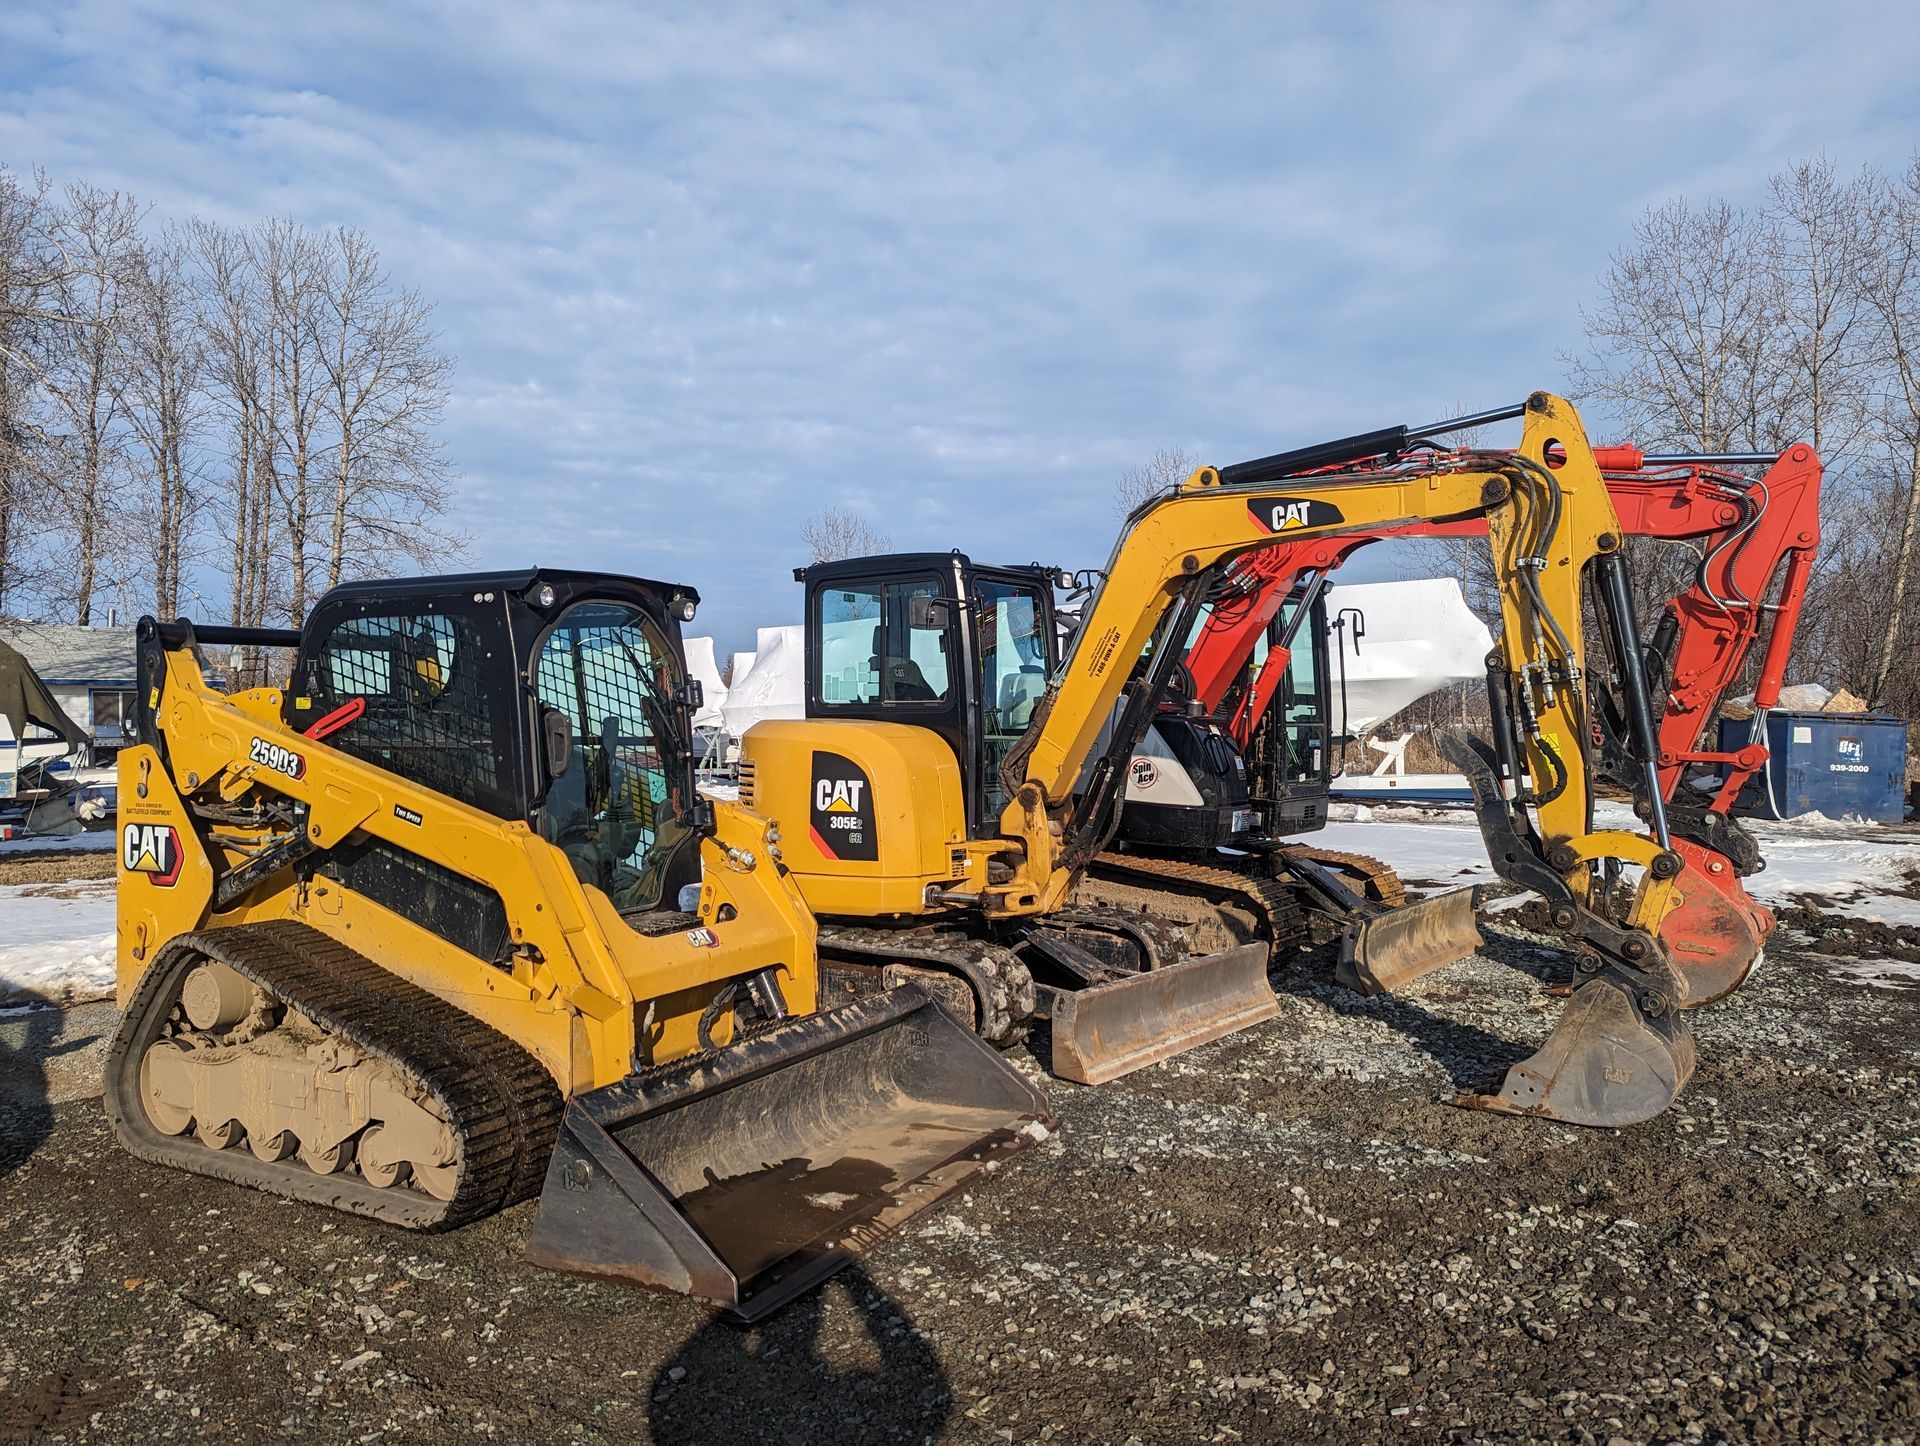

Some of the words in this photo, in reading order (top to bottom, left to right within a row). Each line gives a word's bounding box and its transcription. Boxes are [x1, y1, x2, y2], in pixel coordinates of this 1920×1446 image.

[1272, 501, 1311, 531] CAT
[249, 737, 299, 777] 259D3
[1133, 762, 1152, 774] Spin
[1830, 764, 1869, 773] 939-2000
[1137, 773, 1154, 784] Ace
[816, 779, 864, 812] CAT
[829, 816, 862, 830] 305E2
[848, 832, 862, 844] CR
[124, 824, 170, 872] CAT
[687, 929, 713, 946] CAT
